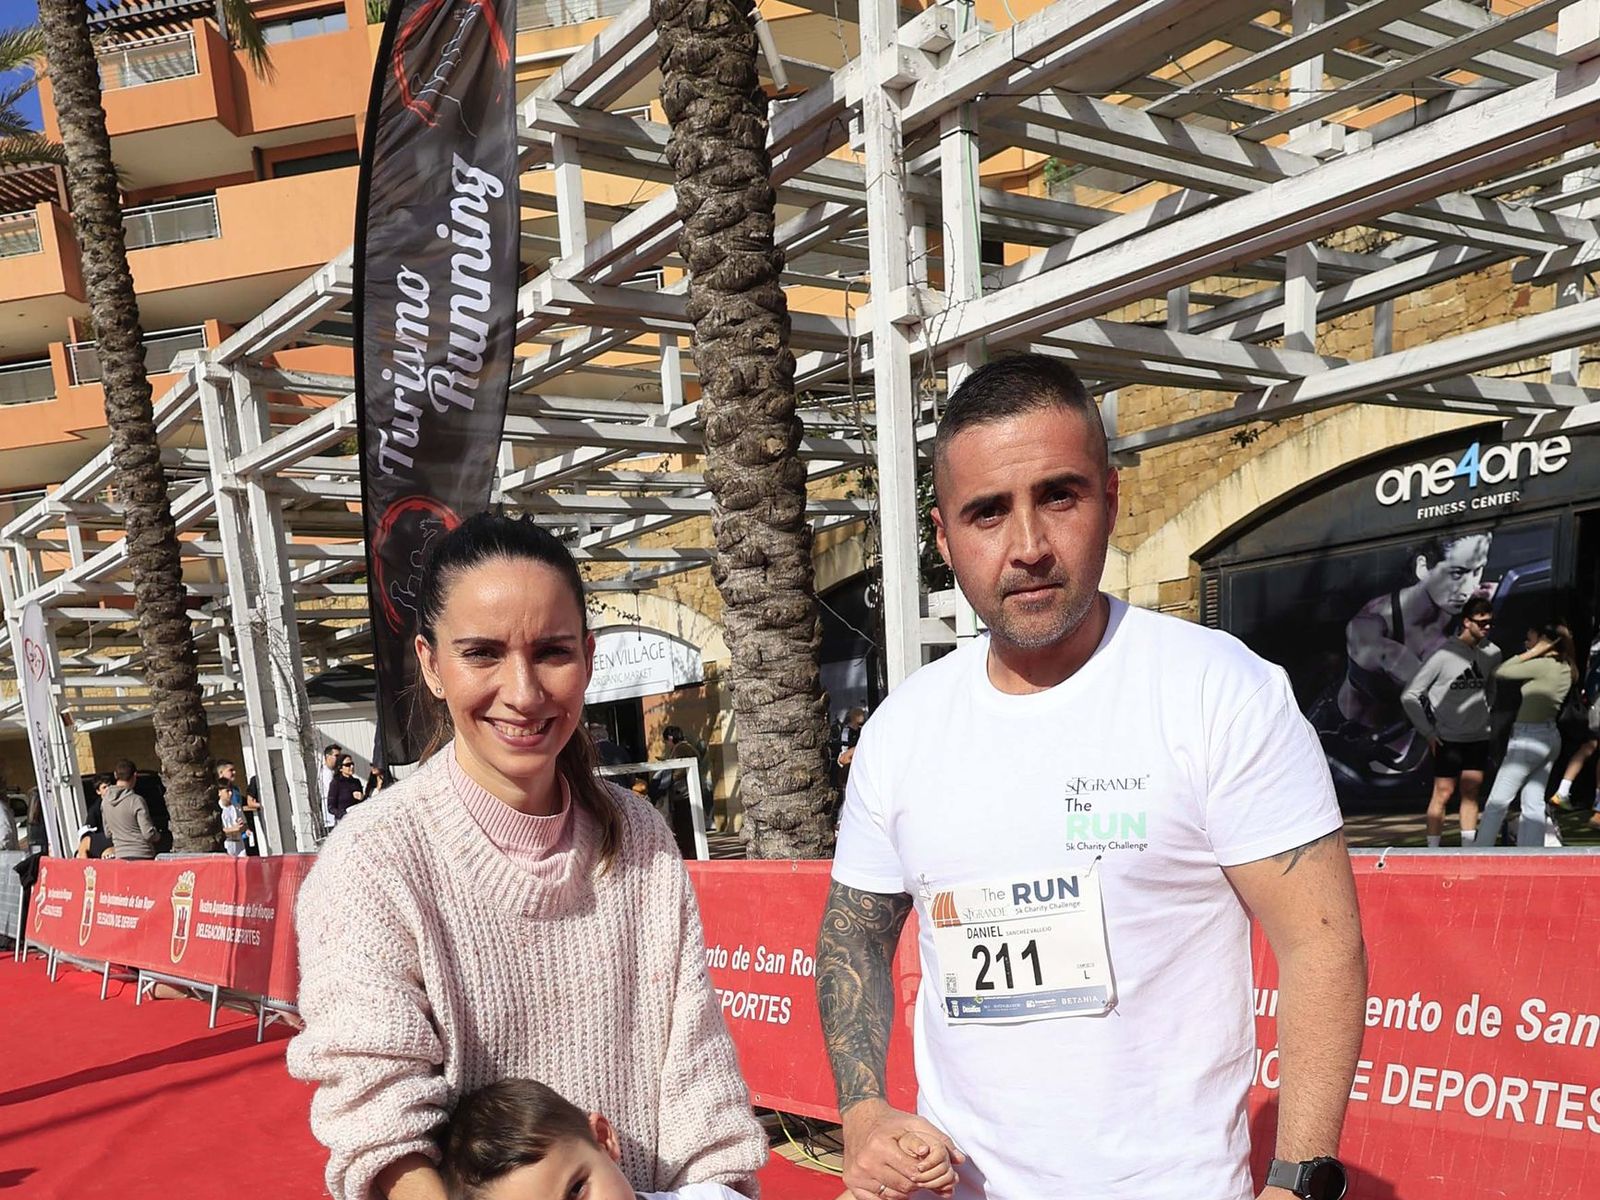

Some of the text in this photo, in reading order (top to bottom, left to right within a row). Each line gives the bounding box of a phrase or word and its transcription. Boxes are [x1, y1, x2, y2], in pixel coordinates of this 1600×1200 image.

[427, 152, 505, 412] Running
[377, 264, 431, 475] Turismo
[1375, 435, 1572, 506] one4one
[1416, 490, 1521, 520] FITNESS CENTER
[593, 642, 666, 671] EEN VILLAGE
[624, 667, 652, 680] MARKET
[1065, 798, 1092, 812] The
[1066, 811, 1147, 841] RUN
[1066, 841, 1149, 853] 5k Charity Challenge
[981, 875, 1080, 906] The RUN
[1024, 904, 1048, 914] Charity
[1049, 901, 1081, 910] Challenge
[967, 926, 1003, 940] DANIEL
[731, 944, 751, 971] de
[754, 945, 786, 974] San
[971, 939, 1043, 991] 211
[1083, 970, 1091, 980] L
[714, 988, 792, 1025] PORTES
[1454, 993, 1503, 1038] de
[1515, 998, 1600, 1048] San
[1349, 1060, 1374, 1101] E
